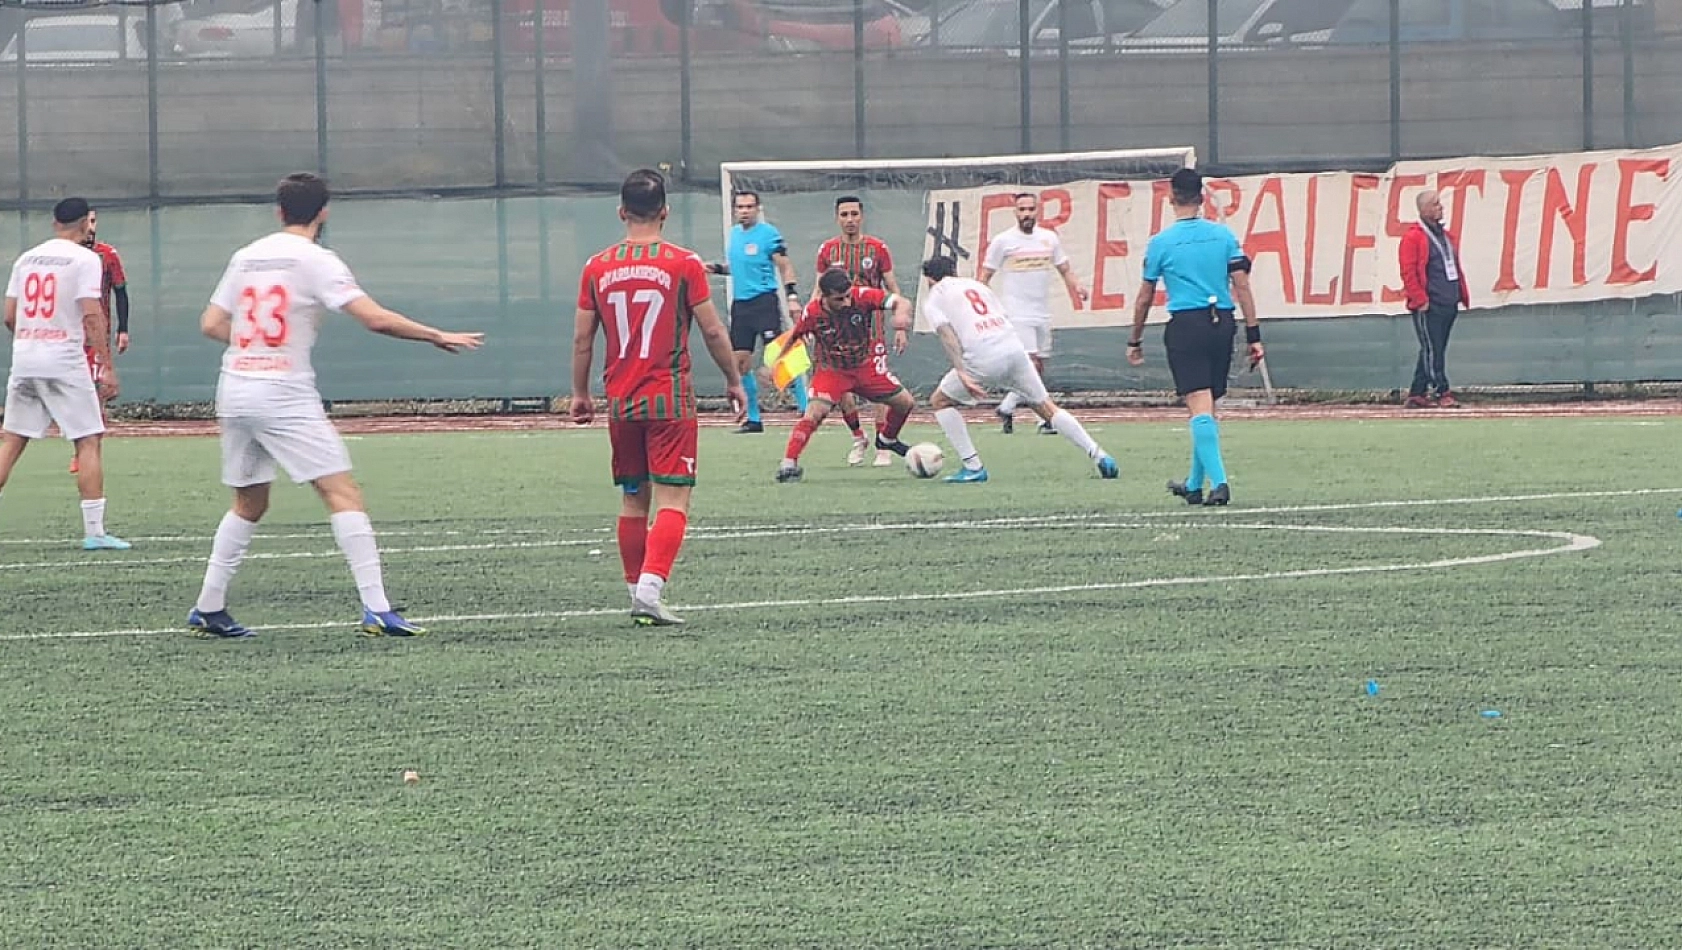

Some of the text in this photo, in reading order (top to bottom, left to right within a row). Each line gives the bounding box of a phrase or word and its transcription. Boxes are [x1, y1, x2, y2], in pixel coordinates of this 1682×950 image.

[1203, 159, 1671, 305] PALESTINE
[24, 272, 56, 319] 99
[237, 284, 288, 348] 33
[607, 289, 665, 359] 17
[965, 288, 988, 316] 8
